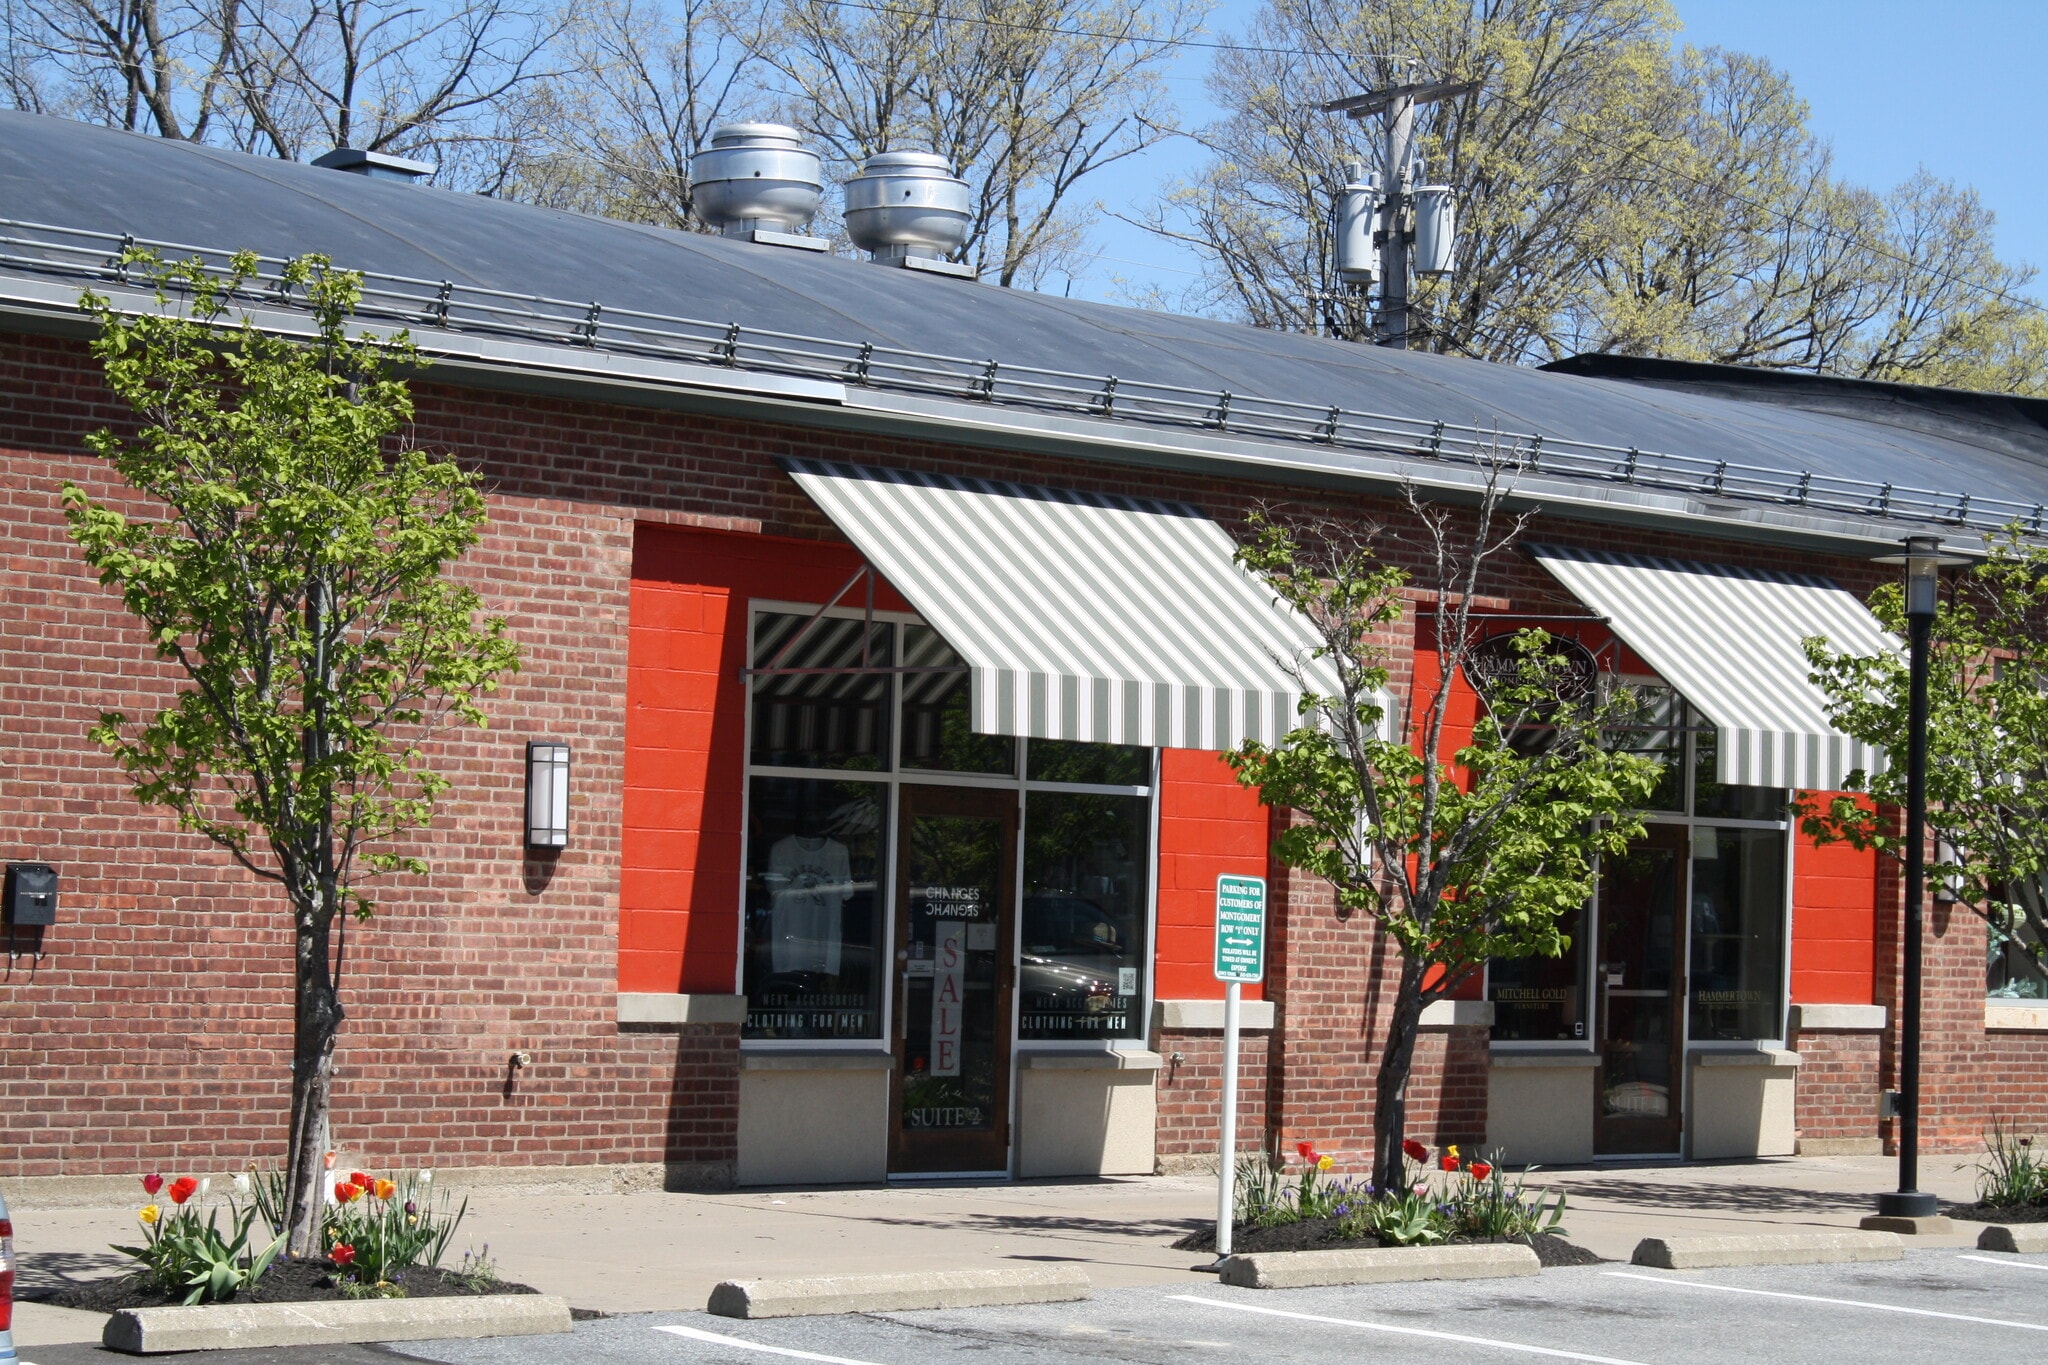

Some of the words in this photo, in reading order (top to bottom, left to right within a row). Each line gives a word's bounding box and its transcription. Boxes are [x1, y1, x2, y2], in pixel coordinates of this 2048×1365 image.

[1474, 655, 1587, 676] HAMMTOWN
[926, 886, 980, 900] CHANGES
[1222, 884, 1248, 895] PARKING
[1249, 886, 1261, 896] FOR
[1220, 897, 1254, 909] CUSTOMERS
[1254, 900, 1263, 910] OF
[1220, 911, 1261, 923] MONTGOMERY
[1220, 924, 1234, 933] ROW
[1243, 926, 1260, 936] ONLY
[1497, 987, 1540, 1000] MITCHELL
[1542, 988, 1567, 1000] GOLD
[1698, 989, 1761, 1001] HAMMERTOWN
[796, 994, 865, 1007] ACCESSORIES
[938, 938, 960, 1070] SALE
[747, 1013, 804, 1029] CLOTHING
[812, 1014, 833, 1028] FOR
[841, 1014, 863, 1028] MEN
[1022, 1016, 1073, 1029] CLOTHING
[1080, 1016, 1099, 1029] FOR
[1106, 1016, 1126, 1030] MEN
[1609, 1094, 1648, 1113] SUITE
[911, 1106, 965, 1127] SUITE
[971, 1106, 981, 1126] 2
